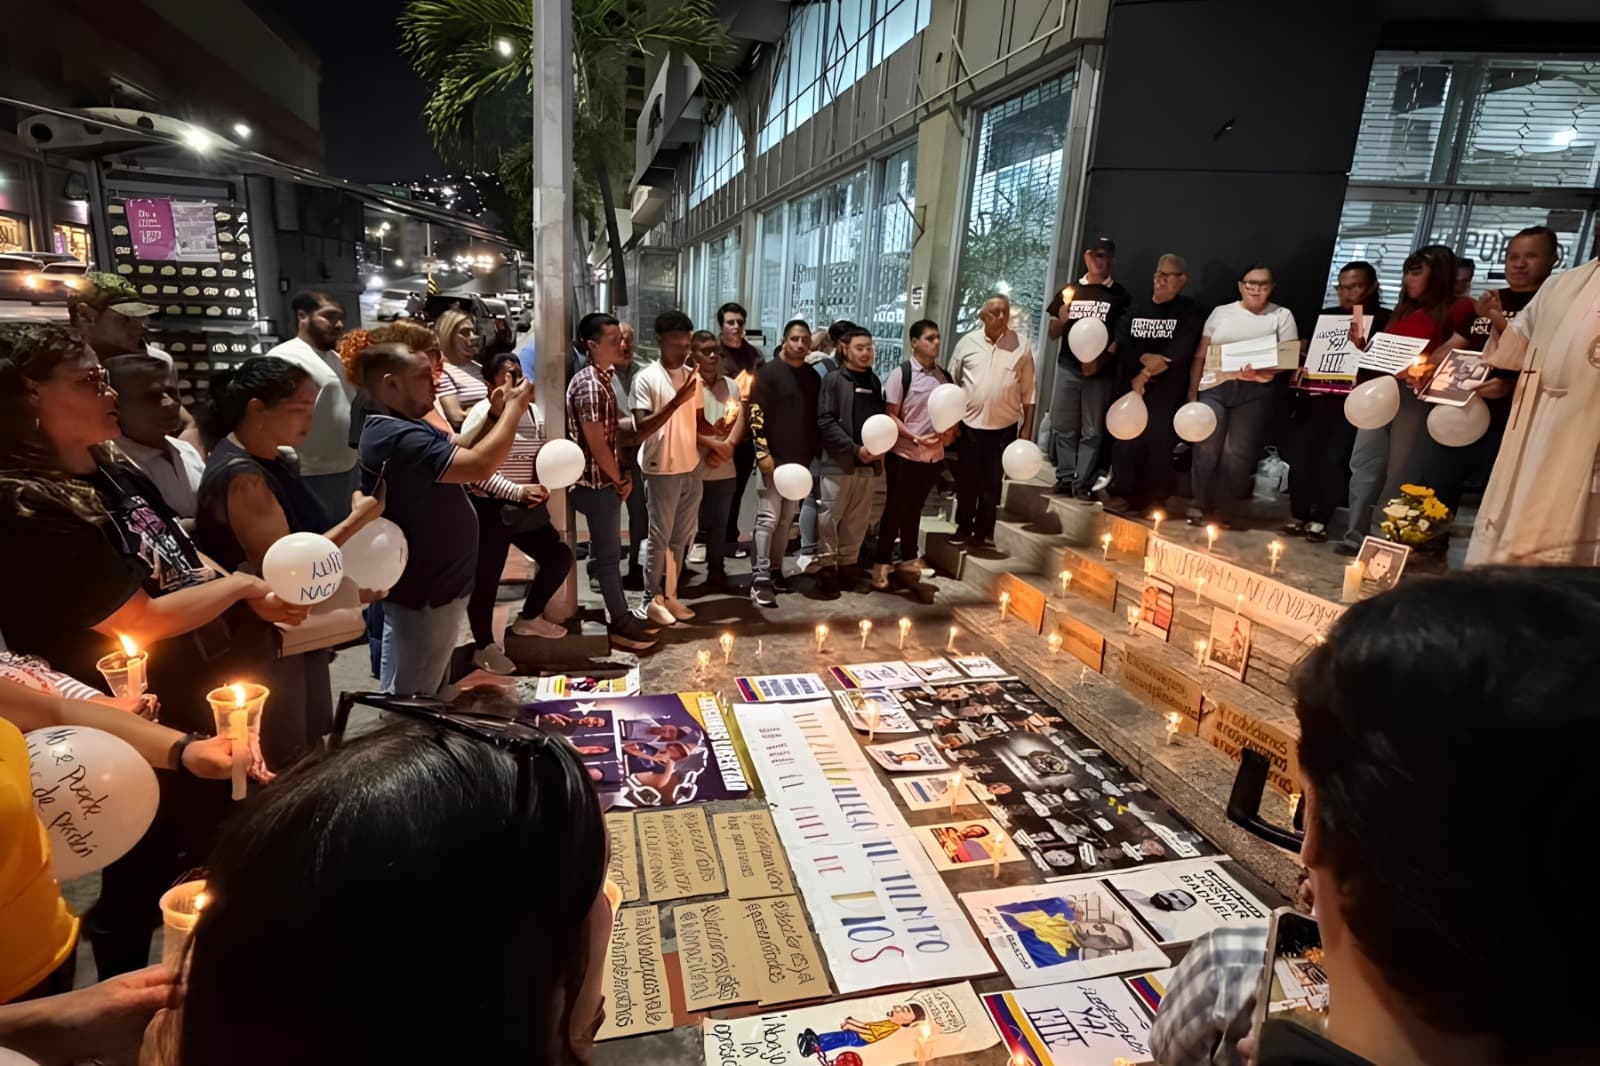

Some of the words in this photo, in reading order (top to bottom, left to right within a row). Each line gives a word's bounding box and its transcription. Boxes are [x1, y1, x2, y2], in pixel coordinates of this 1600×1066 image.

[1180, 875, 1232, 920] BADUEL
[1193, 873, 1250, 919] JOSNAR
[831, 891, 905, 964] DIOS
[740, 1042, 763, 1058] la
